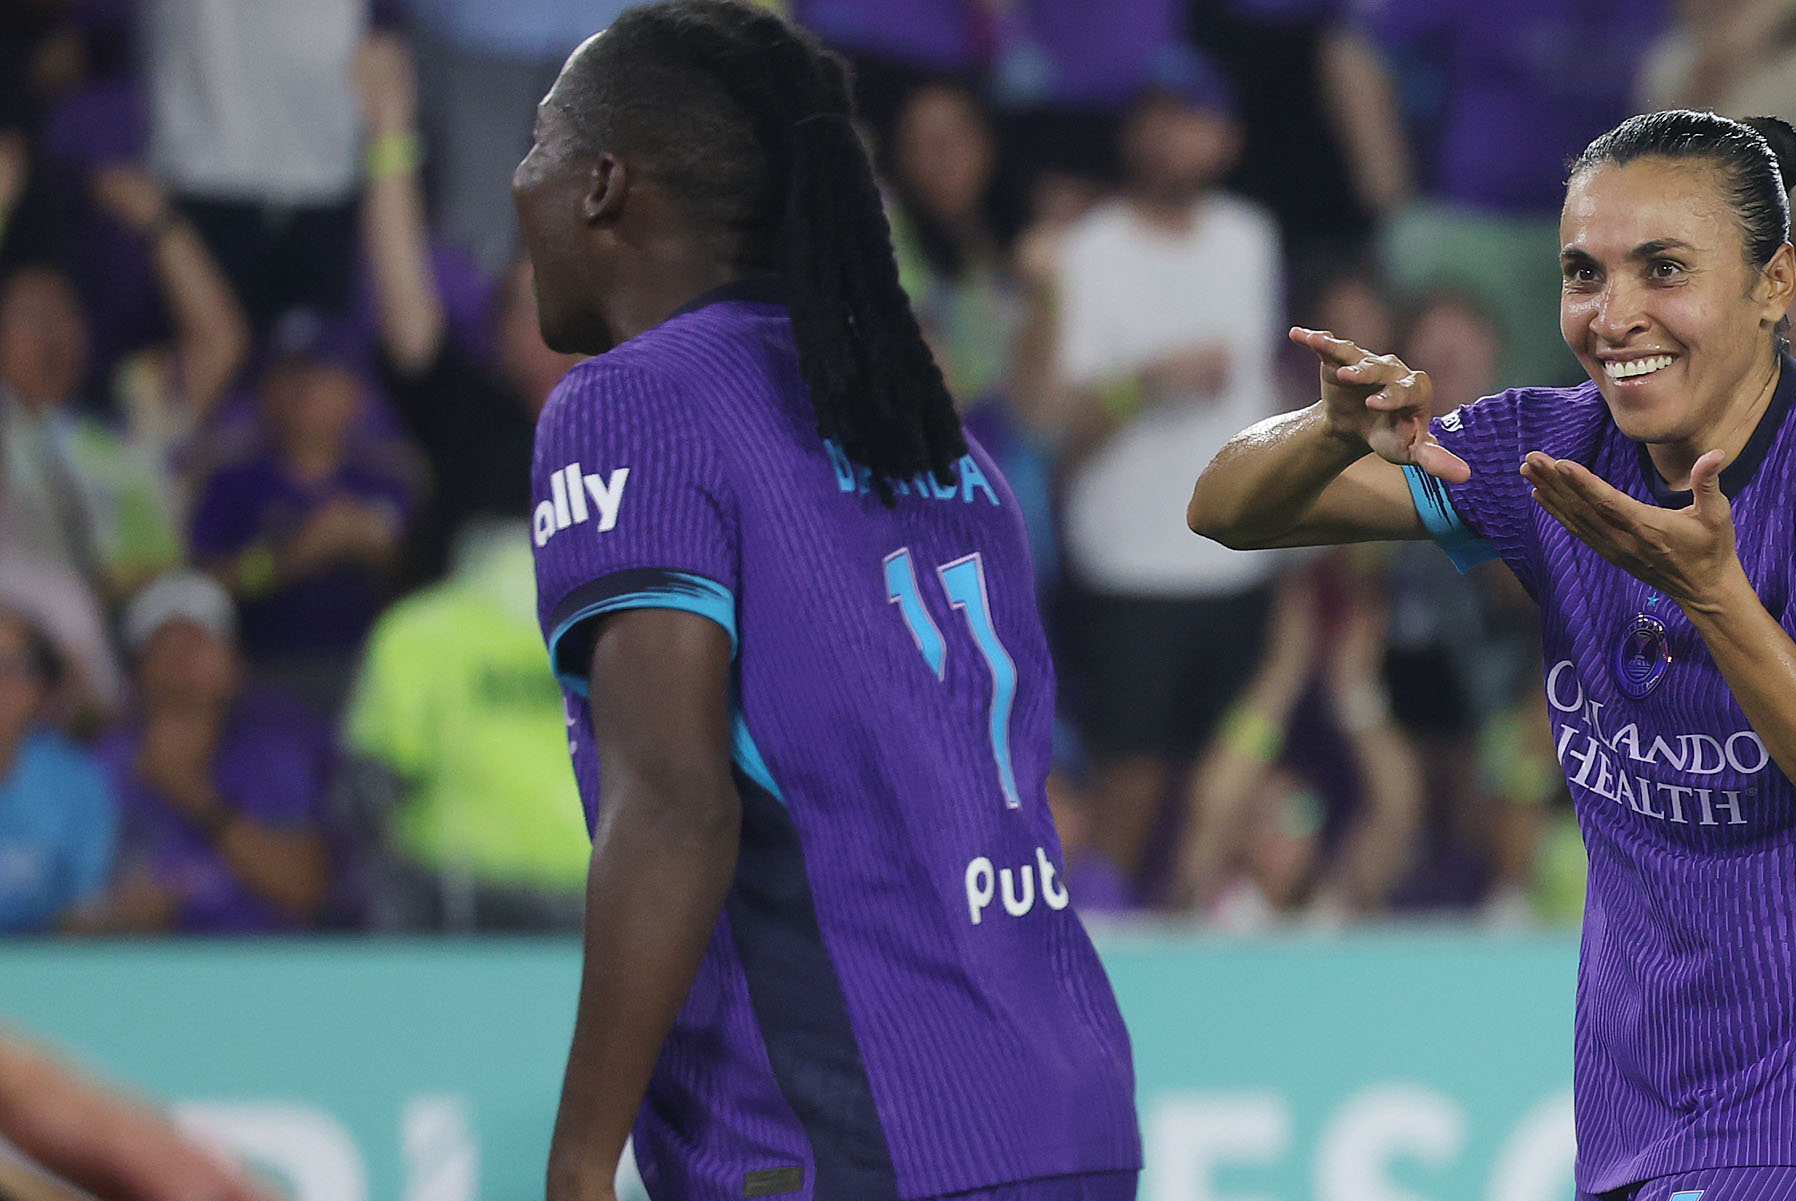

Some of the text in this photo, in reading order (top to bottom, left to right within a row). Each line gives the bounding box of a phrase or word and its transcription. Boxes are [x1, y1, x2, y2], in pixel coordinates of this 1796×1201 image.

[534, 462, 630, 548] ally
[882, 546, 1022, 810] 11
[1557, 723, 1748, 825] HEALTH
